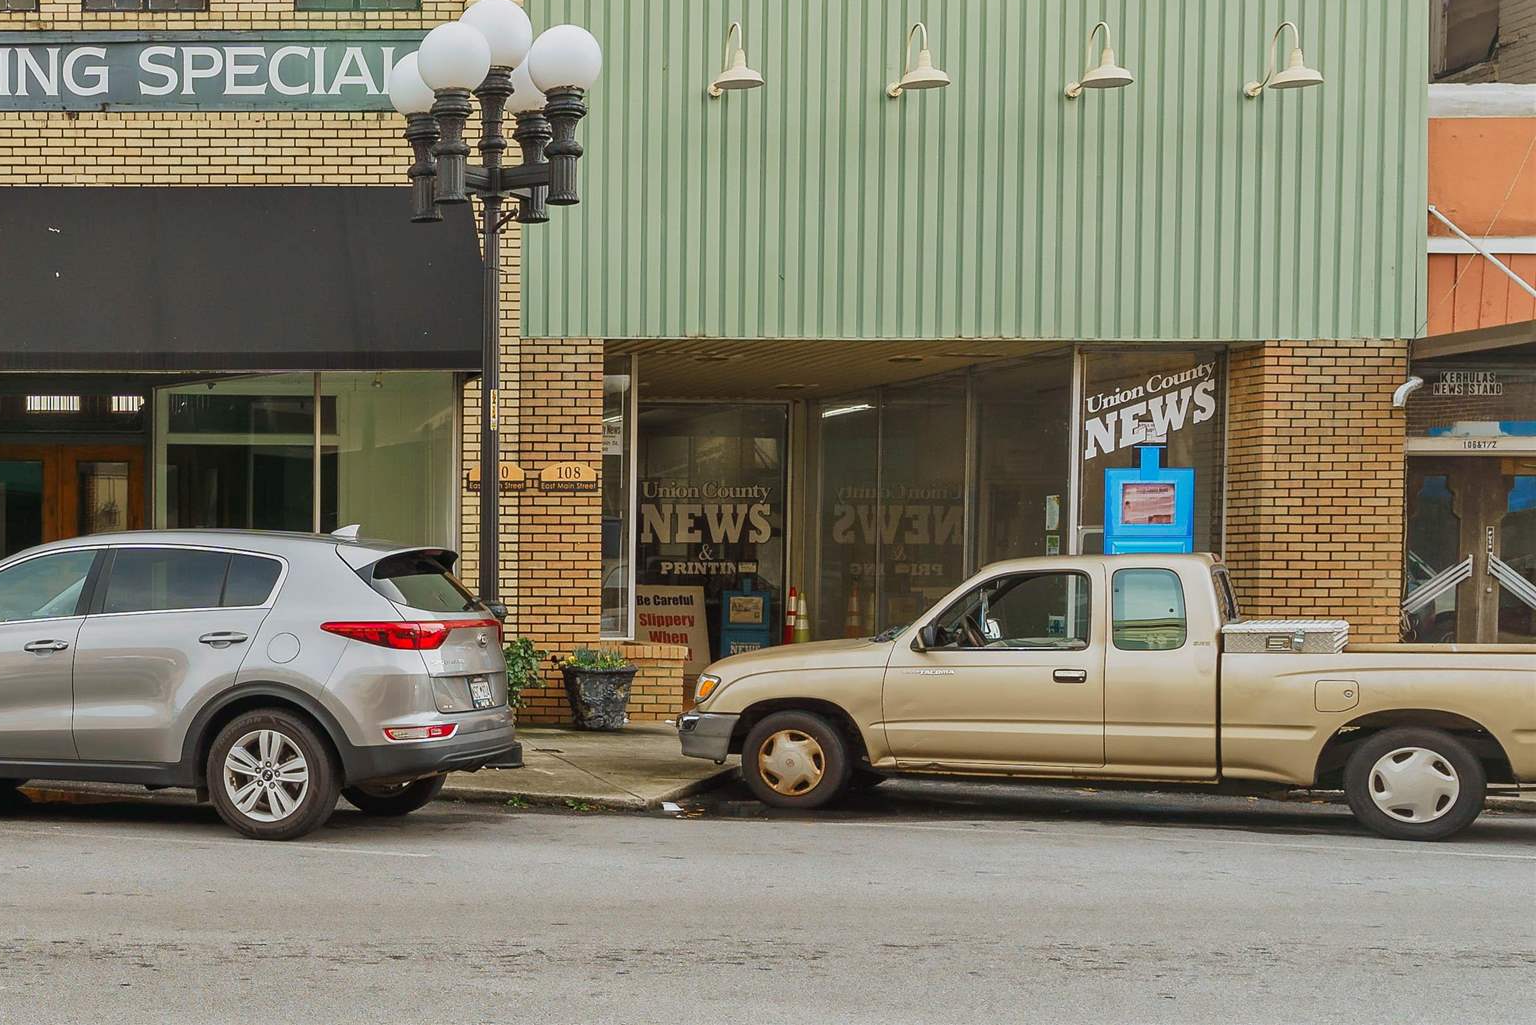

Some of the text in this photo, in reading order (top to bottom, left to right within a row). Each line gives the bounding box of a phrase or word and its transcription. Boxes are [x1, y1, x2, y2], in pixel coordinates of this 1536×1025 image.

[1440, 372, 1496, 383] KERHULAS
[1085, 361, 1216, 414] Union County
[1434, 384, 1463, 394] NEWS
[1084, 378, 1216, 460] NEWS
[557, 466, 581, 479] 108
[541, 482, 556, 490] East
[576, 482, 596, 490] Street
[641, 480, 772, 503] Union County
[640, 503, 772, 544] NEWS
[698, 544, 714, 561] &
[660, 561, 739, 575] PRINTIN
[637, 594, 694, 606] Be Careful
[639, 613, 695, 627] Slippery
[649, 631, 689, 644] When
